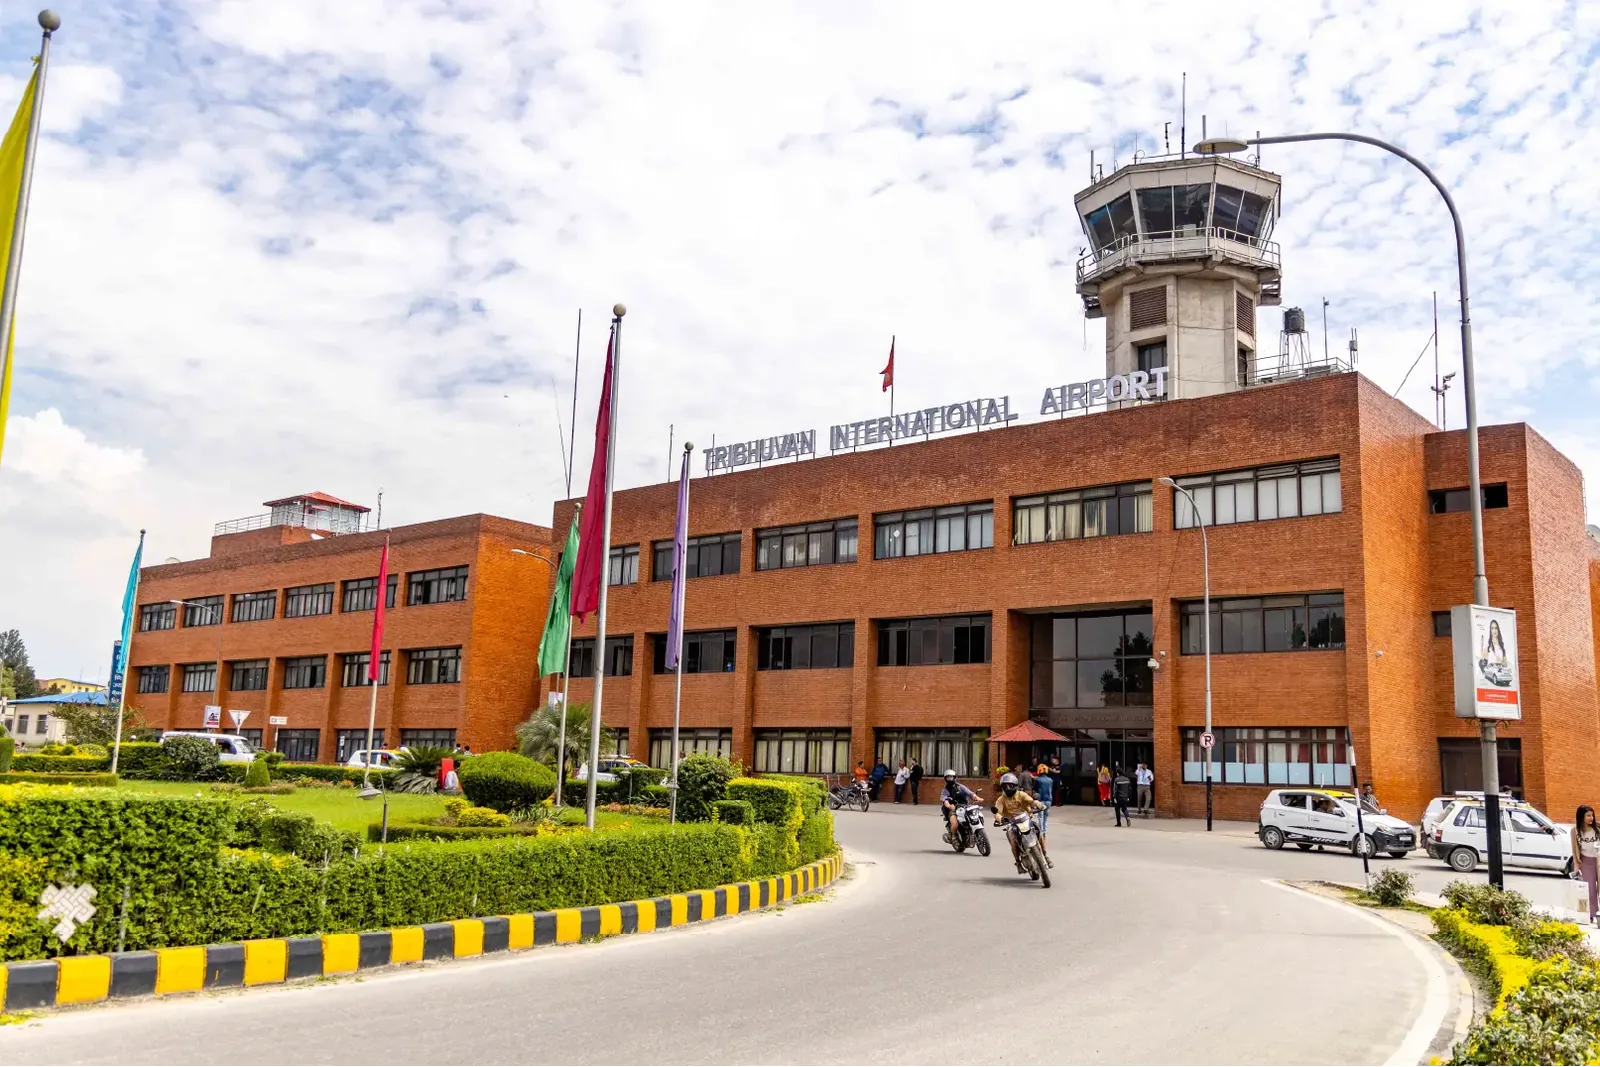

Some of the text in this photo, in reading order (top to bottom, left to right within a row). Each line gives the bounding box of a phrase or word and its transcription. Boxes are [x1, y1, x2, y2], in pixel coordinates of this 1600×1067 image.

[702, 366, 1170, 471] TRIBHUVAN INTERNATIONAL AIRPORT
